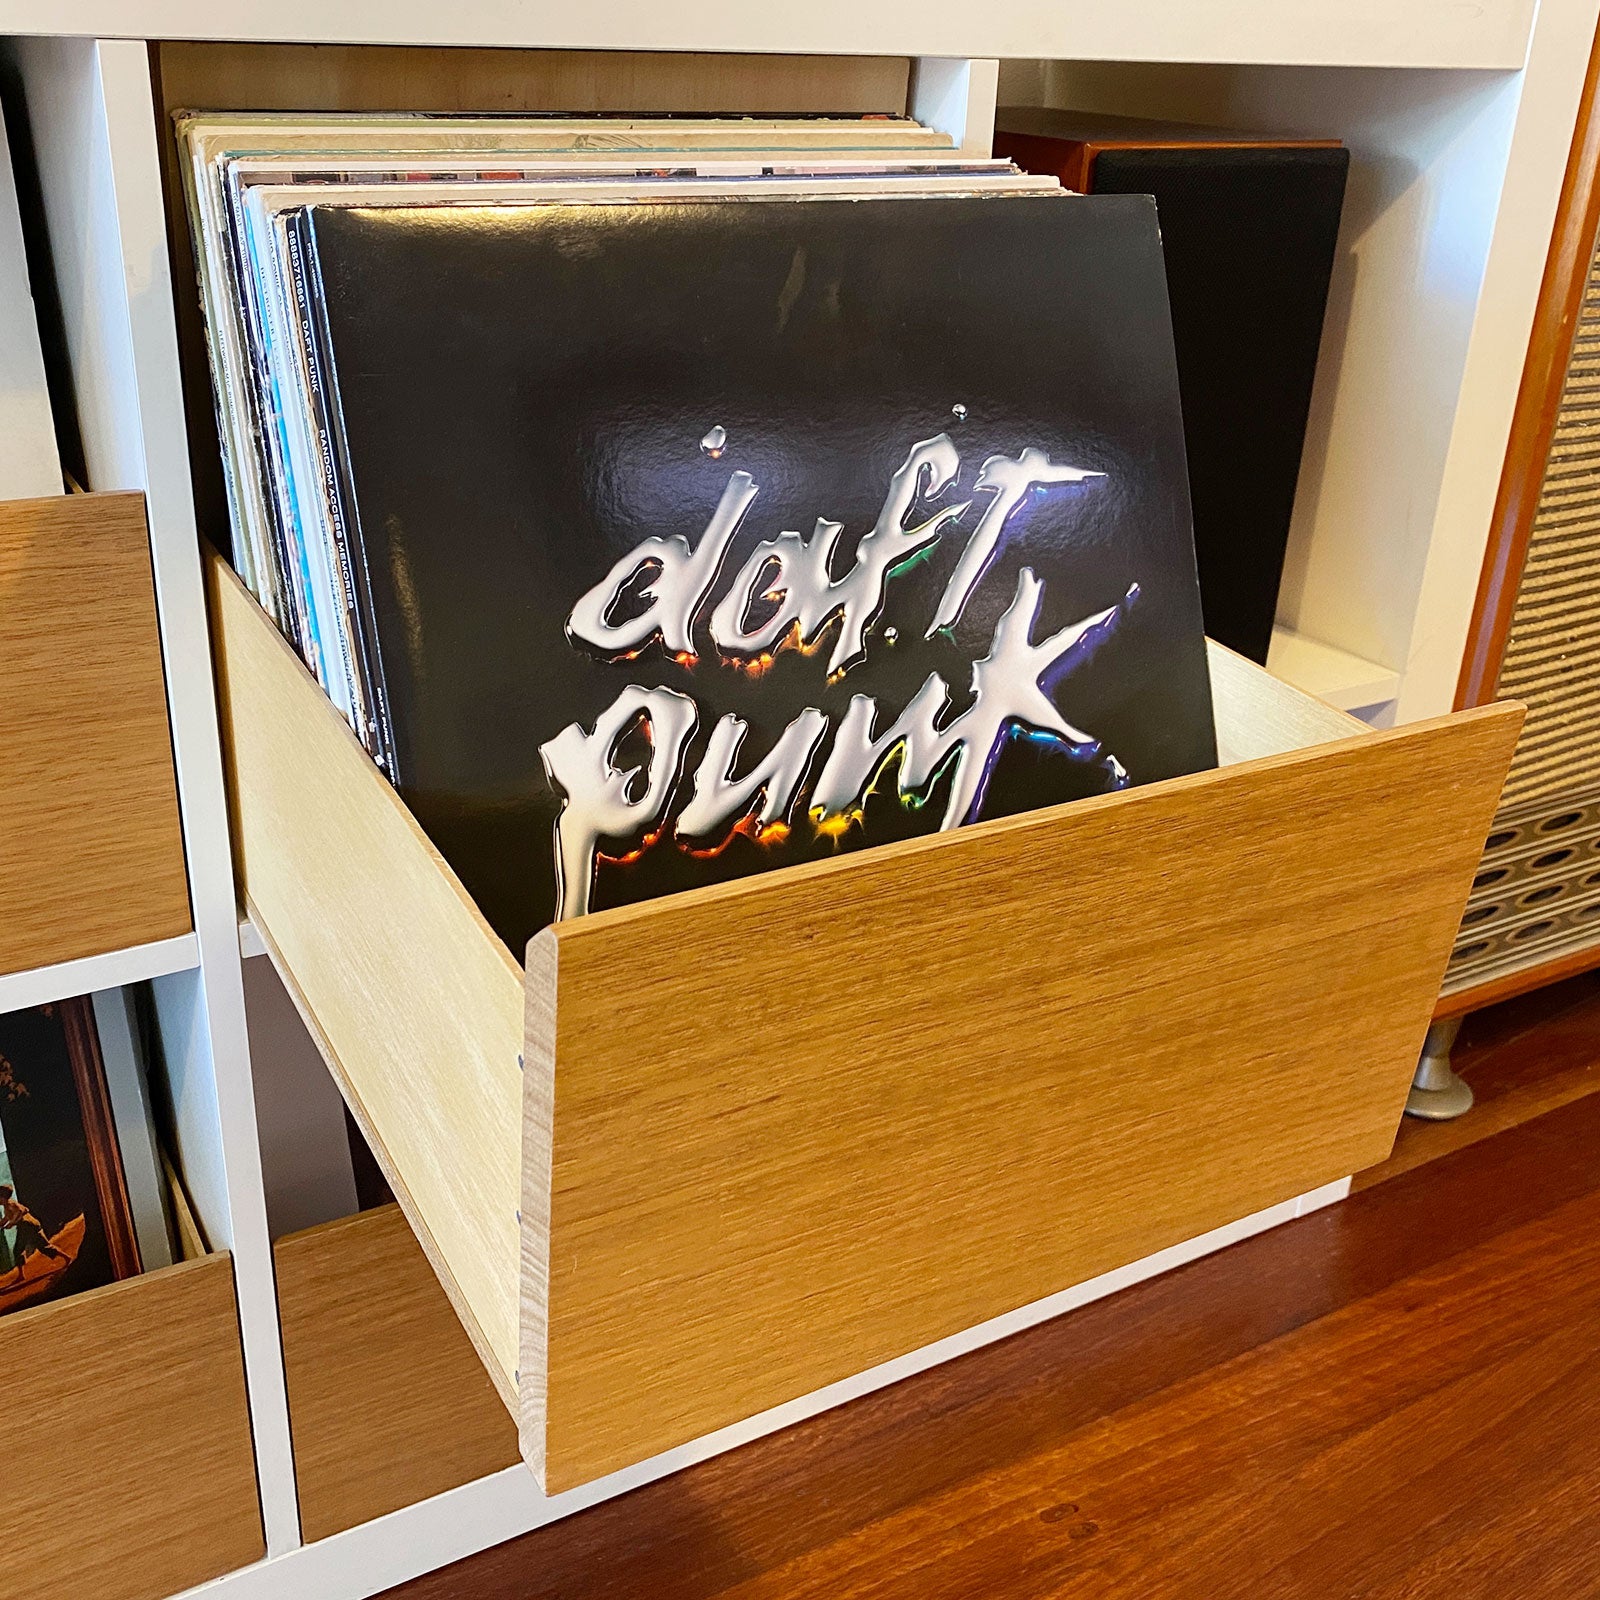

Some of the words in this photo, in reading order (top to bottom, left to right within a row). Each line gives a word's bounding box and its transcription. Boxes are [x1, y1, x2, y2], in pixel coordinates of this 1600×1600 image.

[302, 319, 313, 355] DAFT
[307, 357, 320, 392] PUNK
[319, 429, 332, 484] RANDOM
[327, 486, 343, 538] ACCESS
[337, 542, 354, 609] MEMORIES
[564, 430, 1108, 680] daft
[537, 564, 1140, 922] punk
